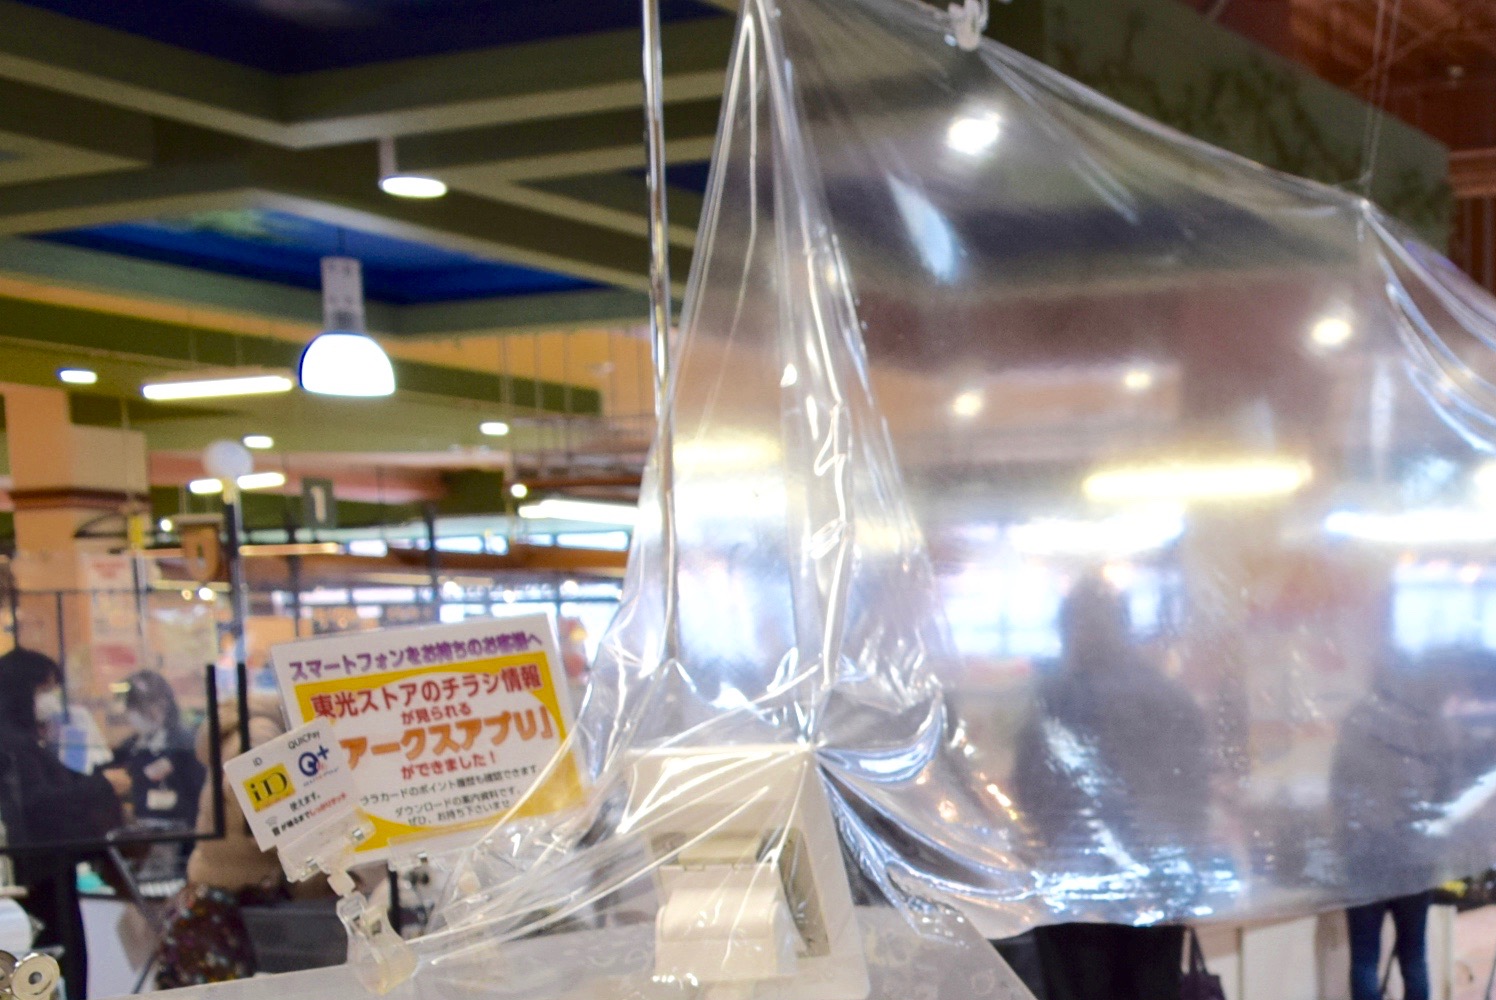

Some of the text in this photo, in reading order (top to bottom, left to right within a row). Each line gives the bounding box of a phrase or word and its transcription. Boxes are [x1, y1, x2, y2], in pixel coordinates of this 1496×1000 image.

[310, 664, 543, 719] 東光ストアのチラシ情報
[401, 701, 472, 726] が見られる
[250, 772, 288, 802] iD
